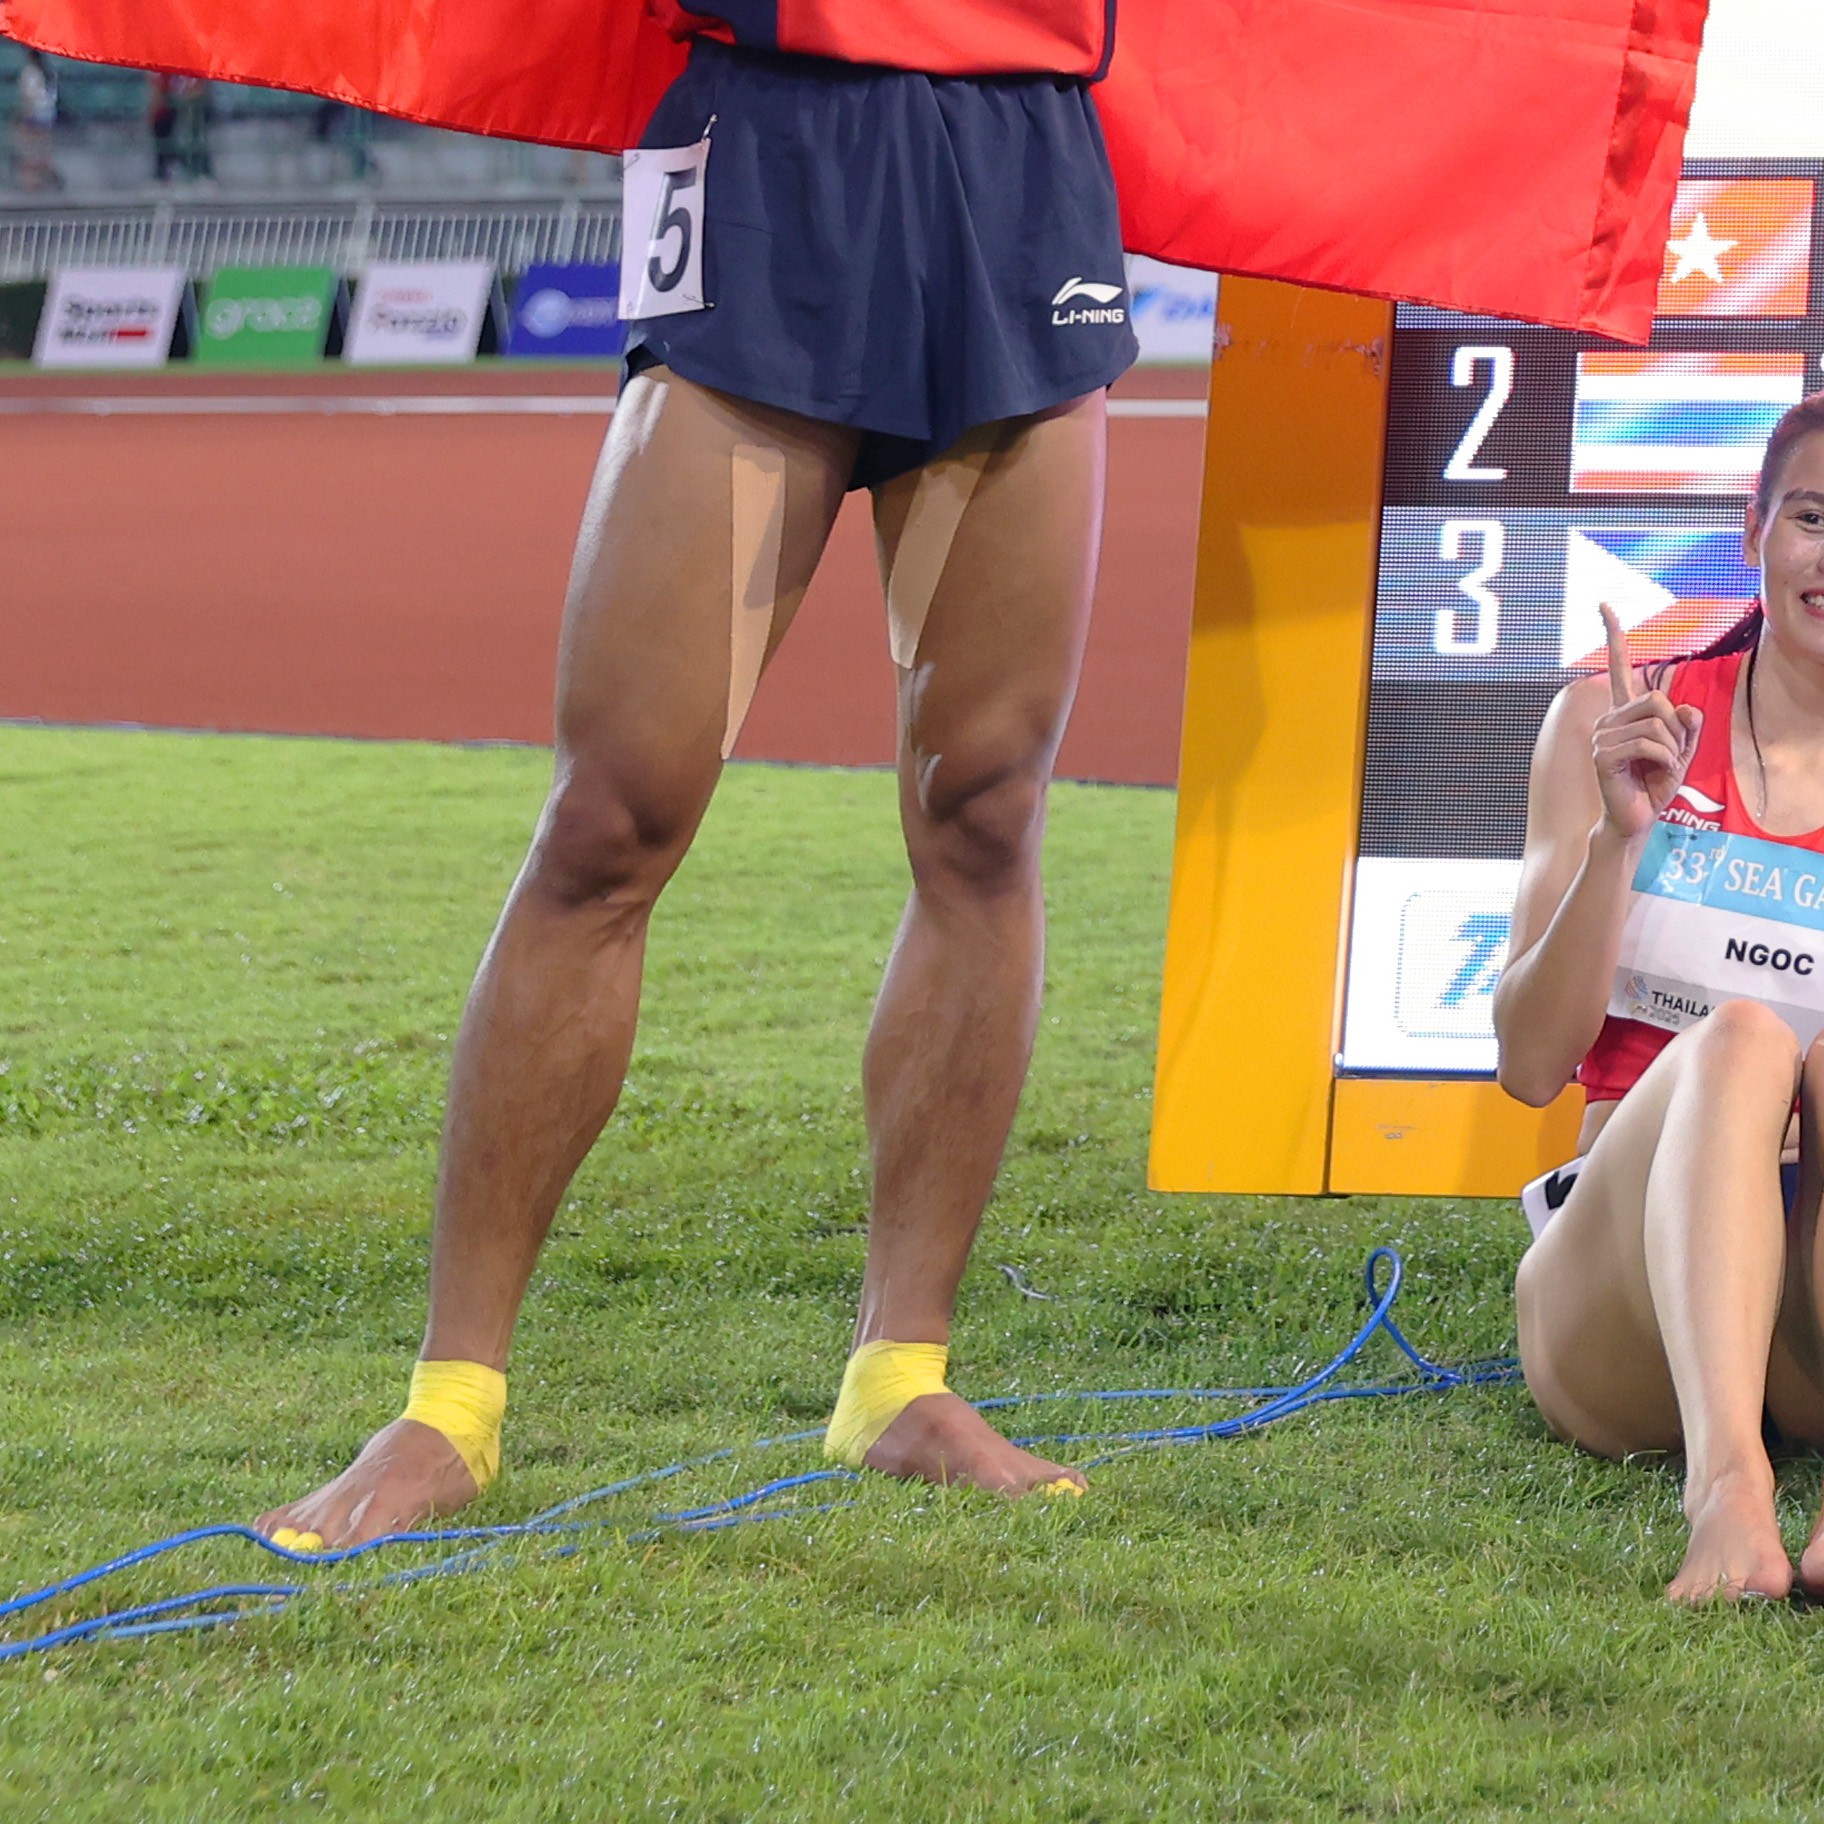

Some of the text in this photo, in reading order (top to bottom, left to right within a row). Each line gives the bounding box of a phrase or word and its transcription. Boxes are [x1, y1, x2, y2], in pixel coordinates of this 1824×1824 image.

[646, 166, 698, 293] 5
[1051, 307, 1125, 326] LI-NING
[1443, 344, 1516, 483] 2
[1432, 518, 1507, 657] 3
[1724, 858, 1784, 902] SEA
[1724, 937, 1816, 977] NGOC
[1652, 990, 1716, 1018] THAILA
